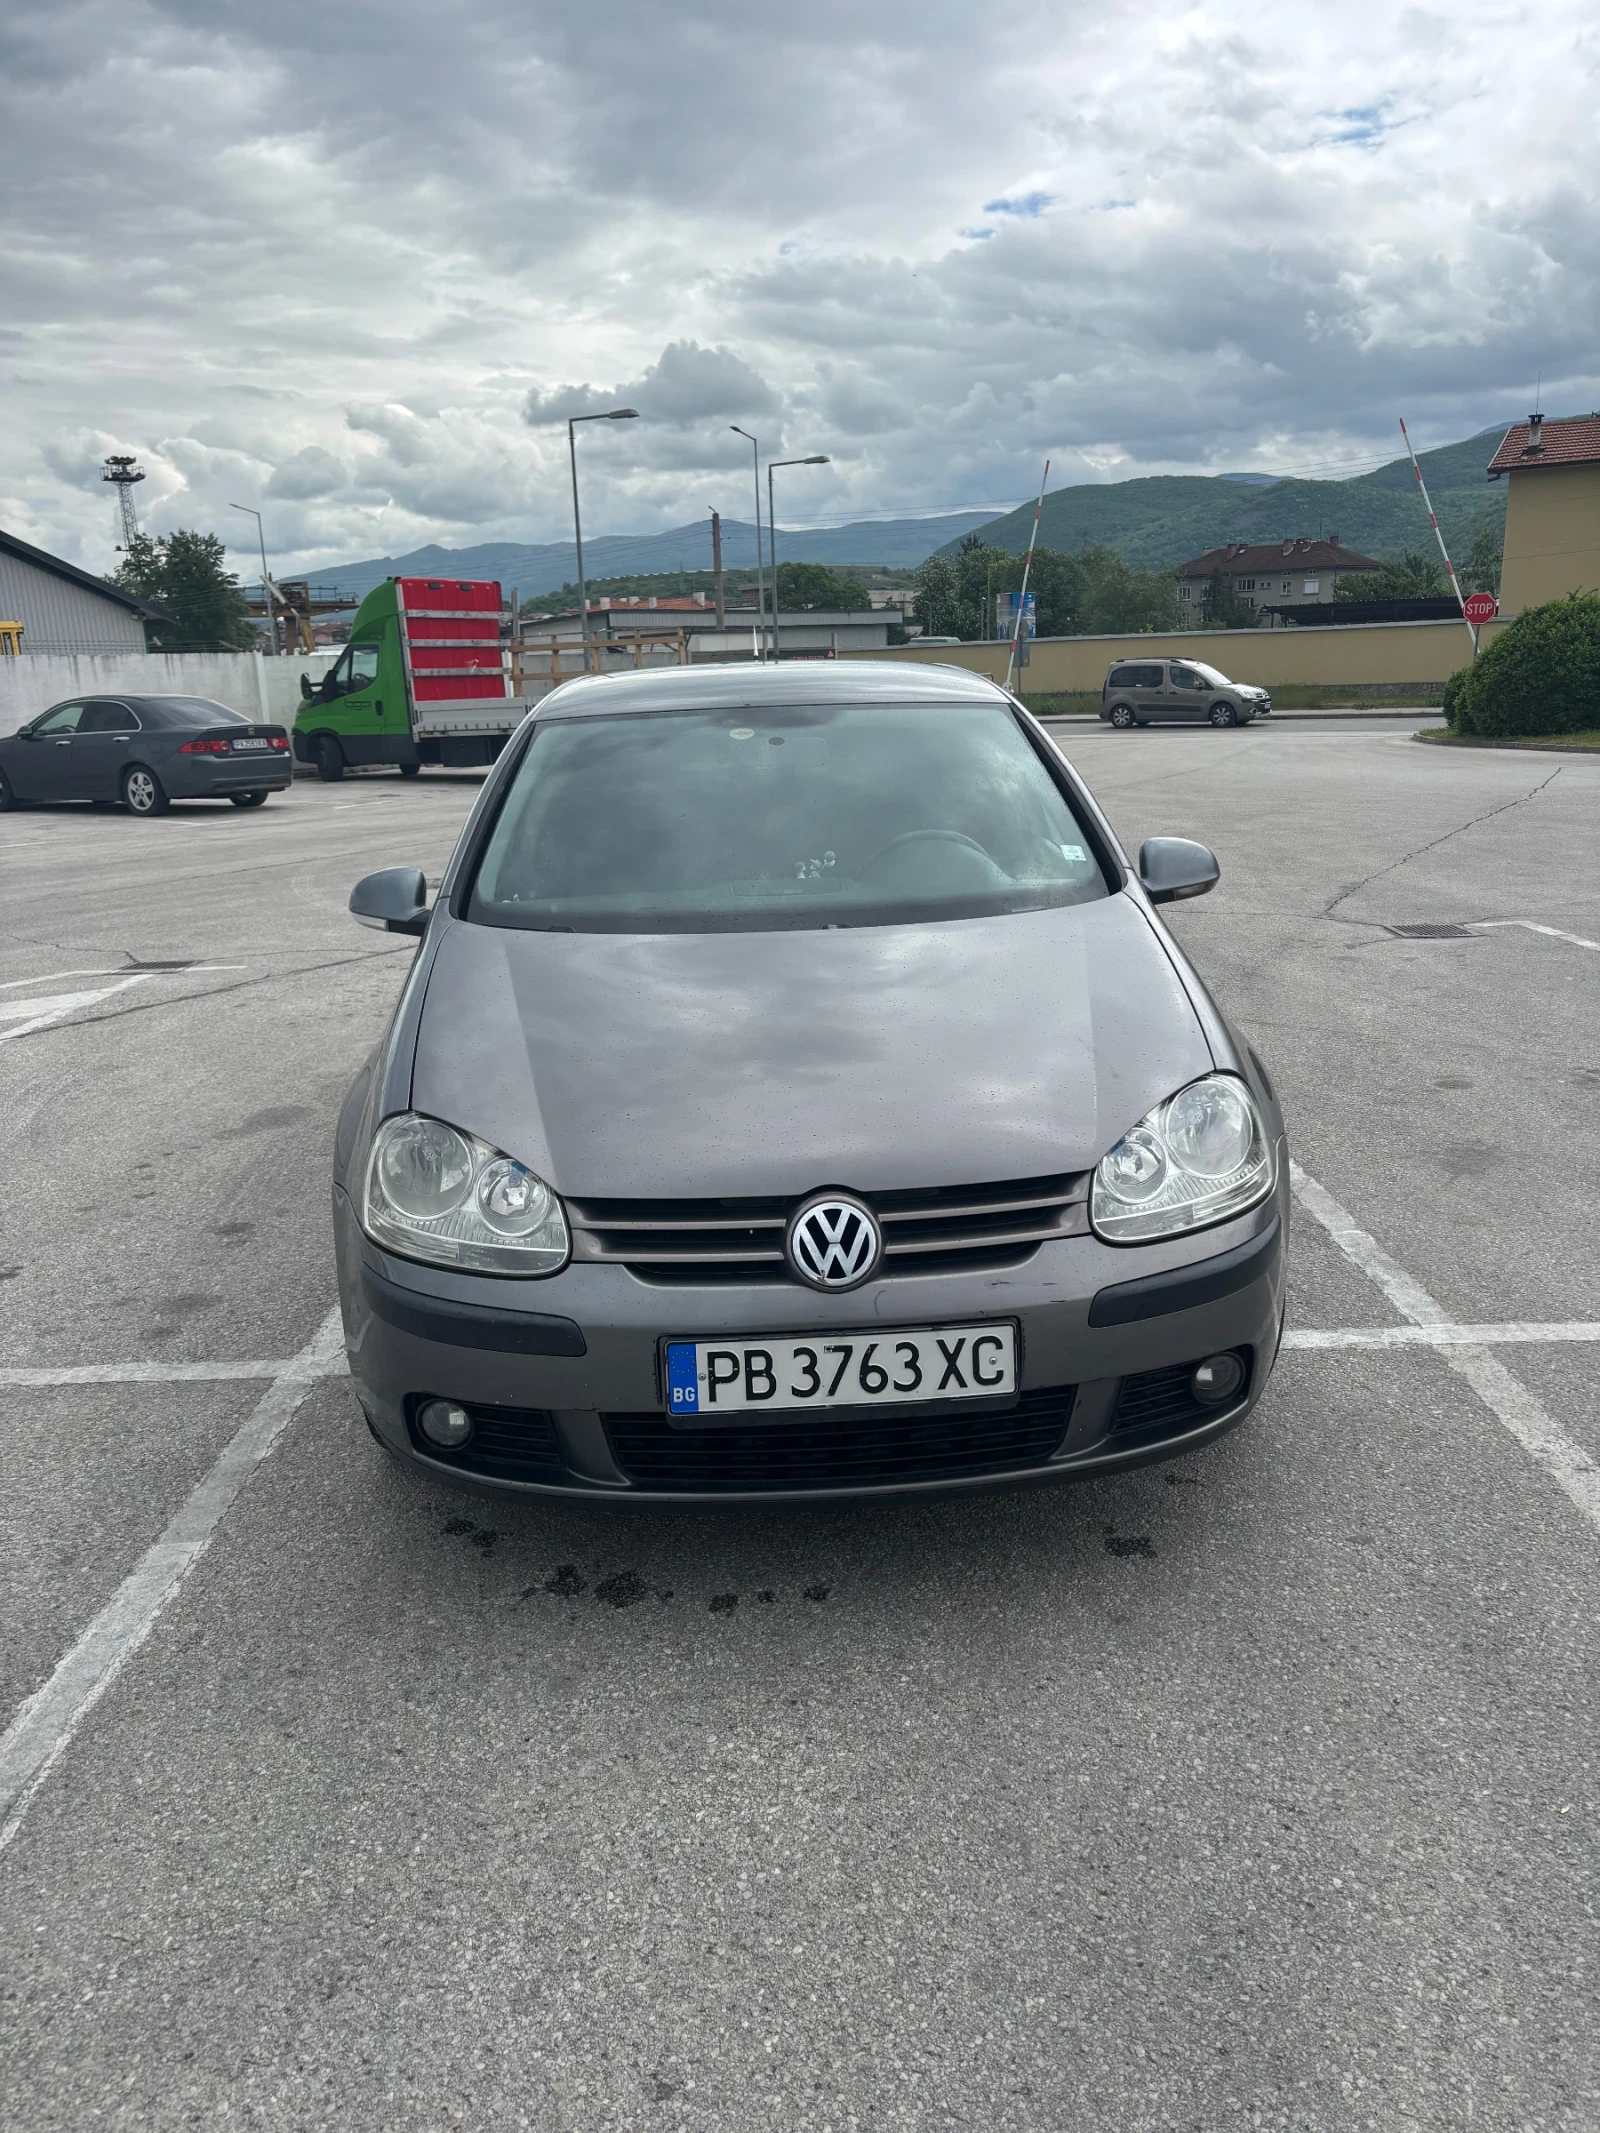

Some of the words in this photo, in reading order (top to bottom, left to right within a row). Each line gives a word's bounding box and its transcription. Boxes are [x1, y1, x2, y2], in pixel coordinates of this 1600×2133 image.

[1466, 603, 1492, 614] STOP
[797, 1206, 872, 1283] VW
[707, 1347, 778, 1402] PB
[791, 1341, 924, 1397] 3763
[936, 1335, 1005, 1390] XC
[673, 1386, 696, 1403] BG
